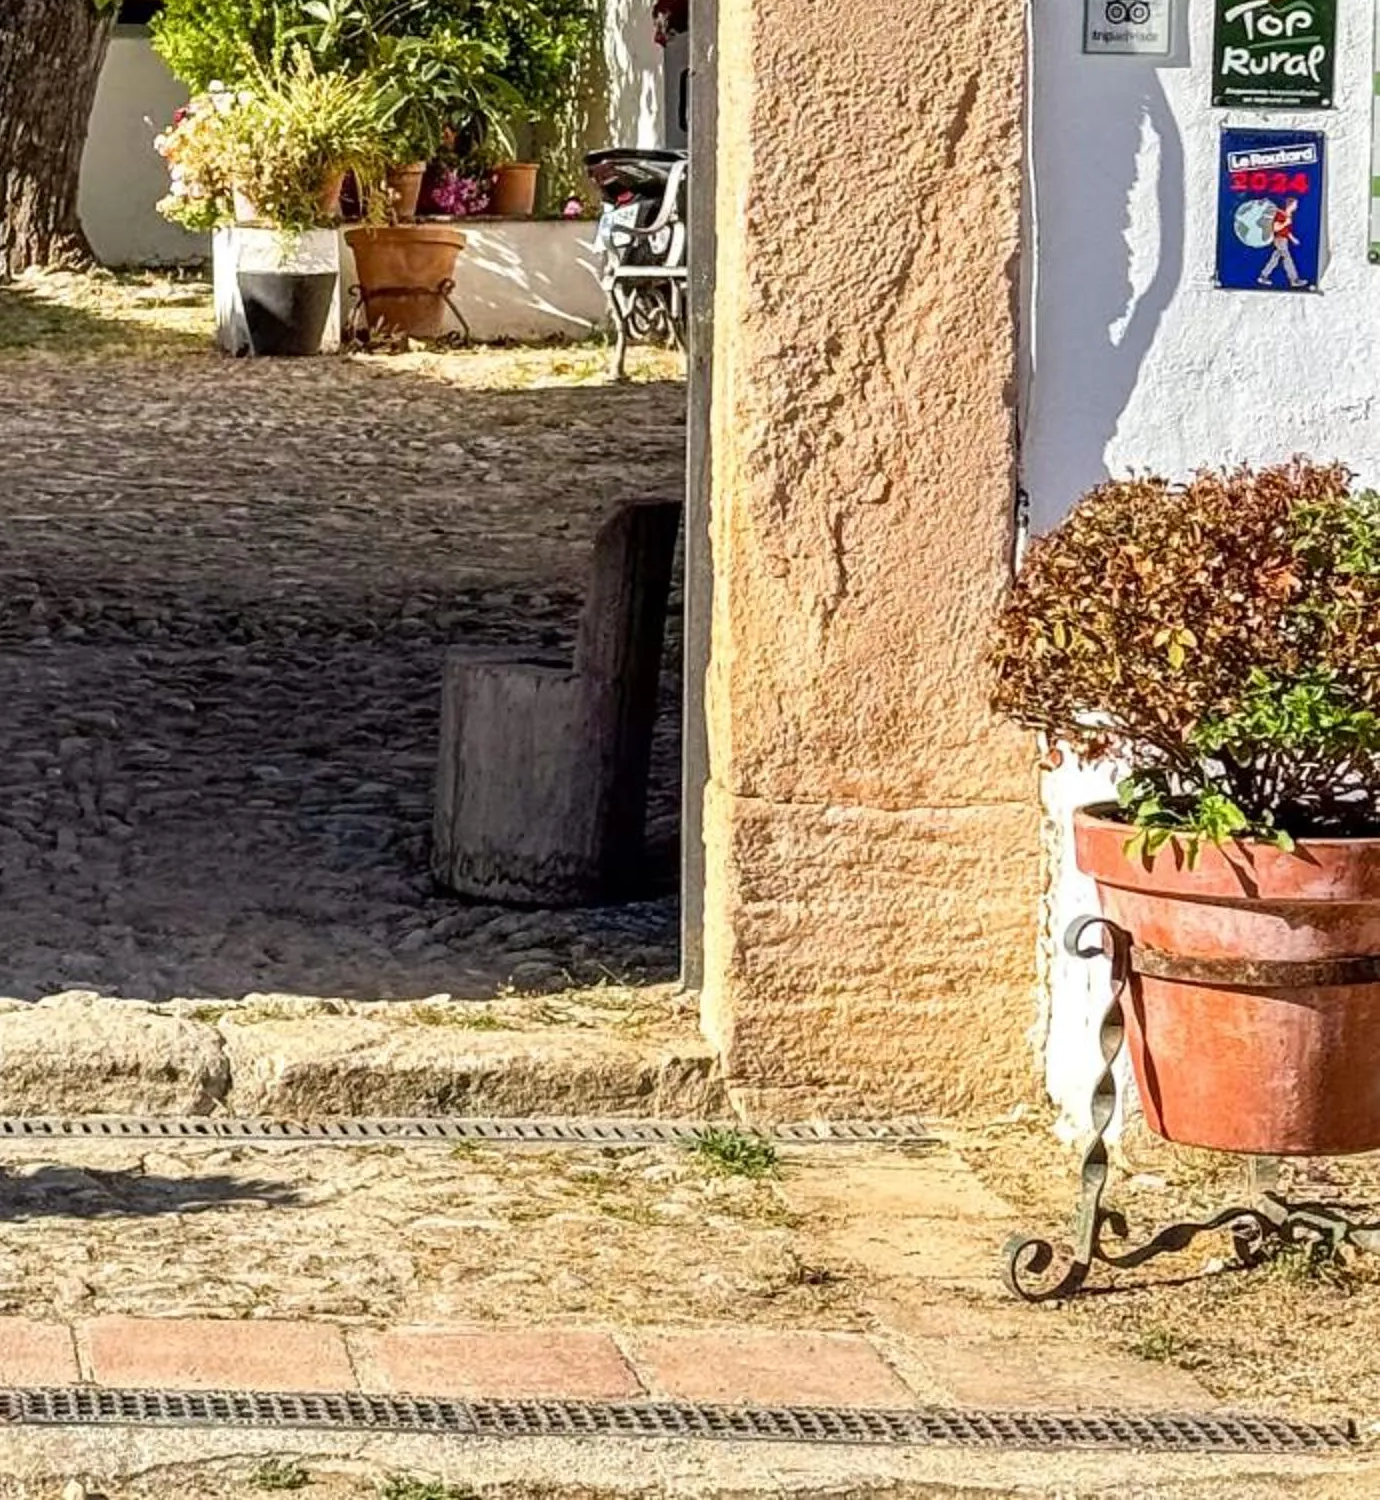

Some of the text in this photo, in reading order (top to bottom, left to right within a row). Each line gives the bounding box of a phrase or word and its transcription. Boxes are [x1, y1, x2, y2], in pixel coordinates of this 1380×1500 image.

[1221, 44, 1325, 82] Rural
[1231, 148, 1313, 168] Le Routard
[1230, 172, 1308, 193] 2024
